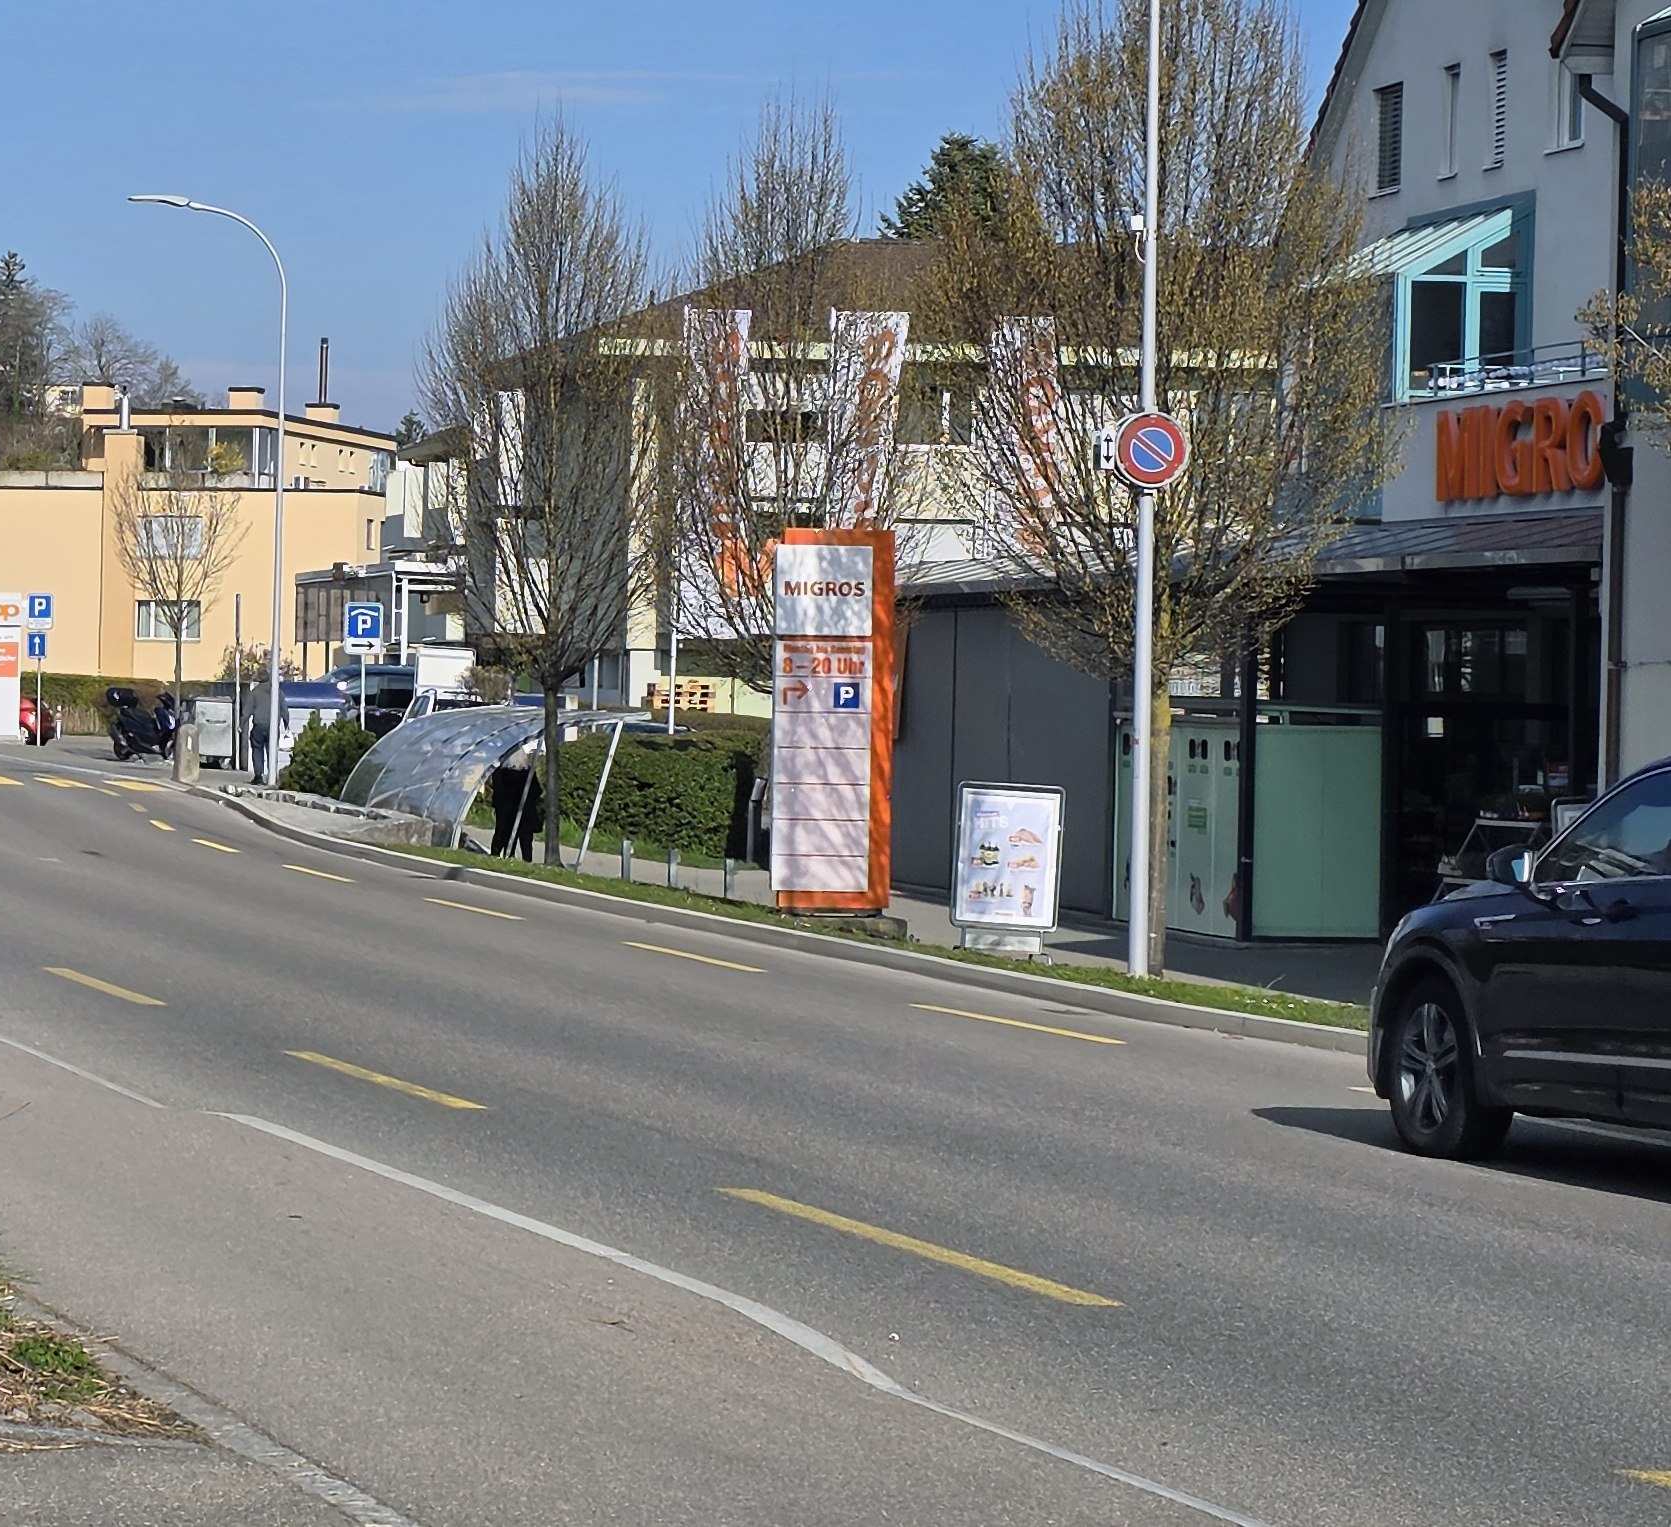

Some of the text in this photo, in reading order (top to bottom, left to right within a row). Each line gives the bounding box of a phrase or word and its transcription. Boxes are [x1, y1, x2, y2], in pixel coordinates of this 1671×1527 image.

[784, 580, 866, 597] MIGROS
[34, 597, 47, 617] P
[357, 614, 372, 636] P
[782, 656, 793, 674] 8
[811, 656, 832, 675] 20
[837, 656, 866, 676] Uhr
[839, 686, 855, 706] P
